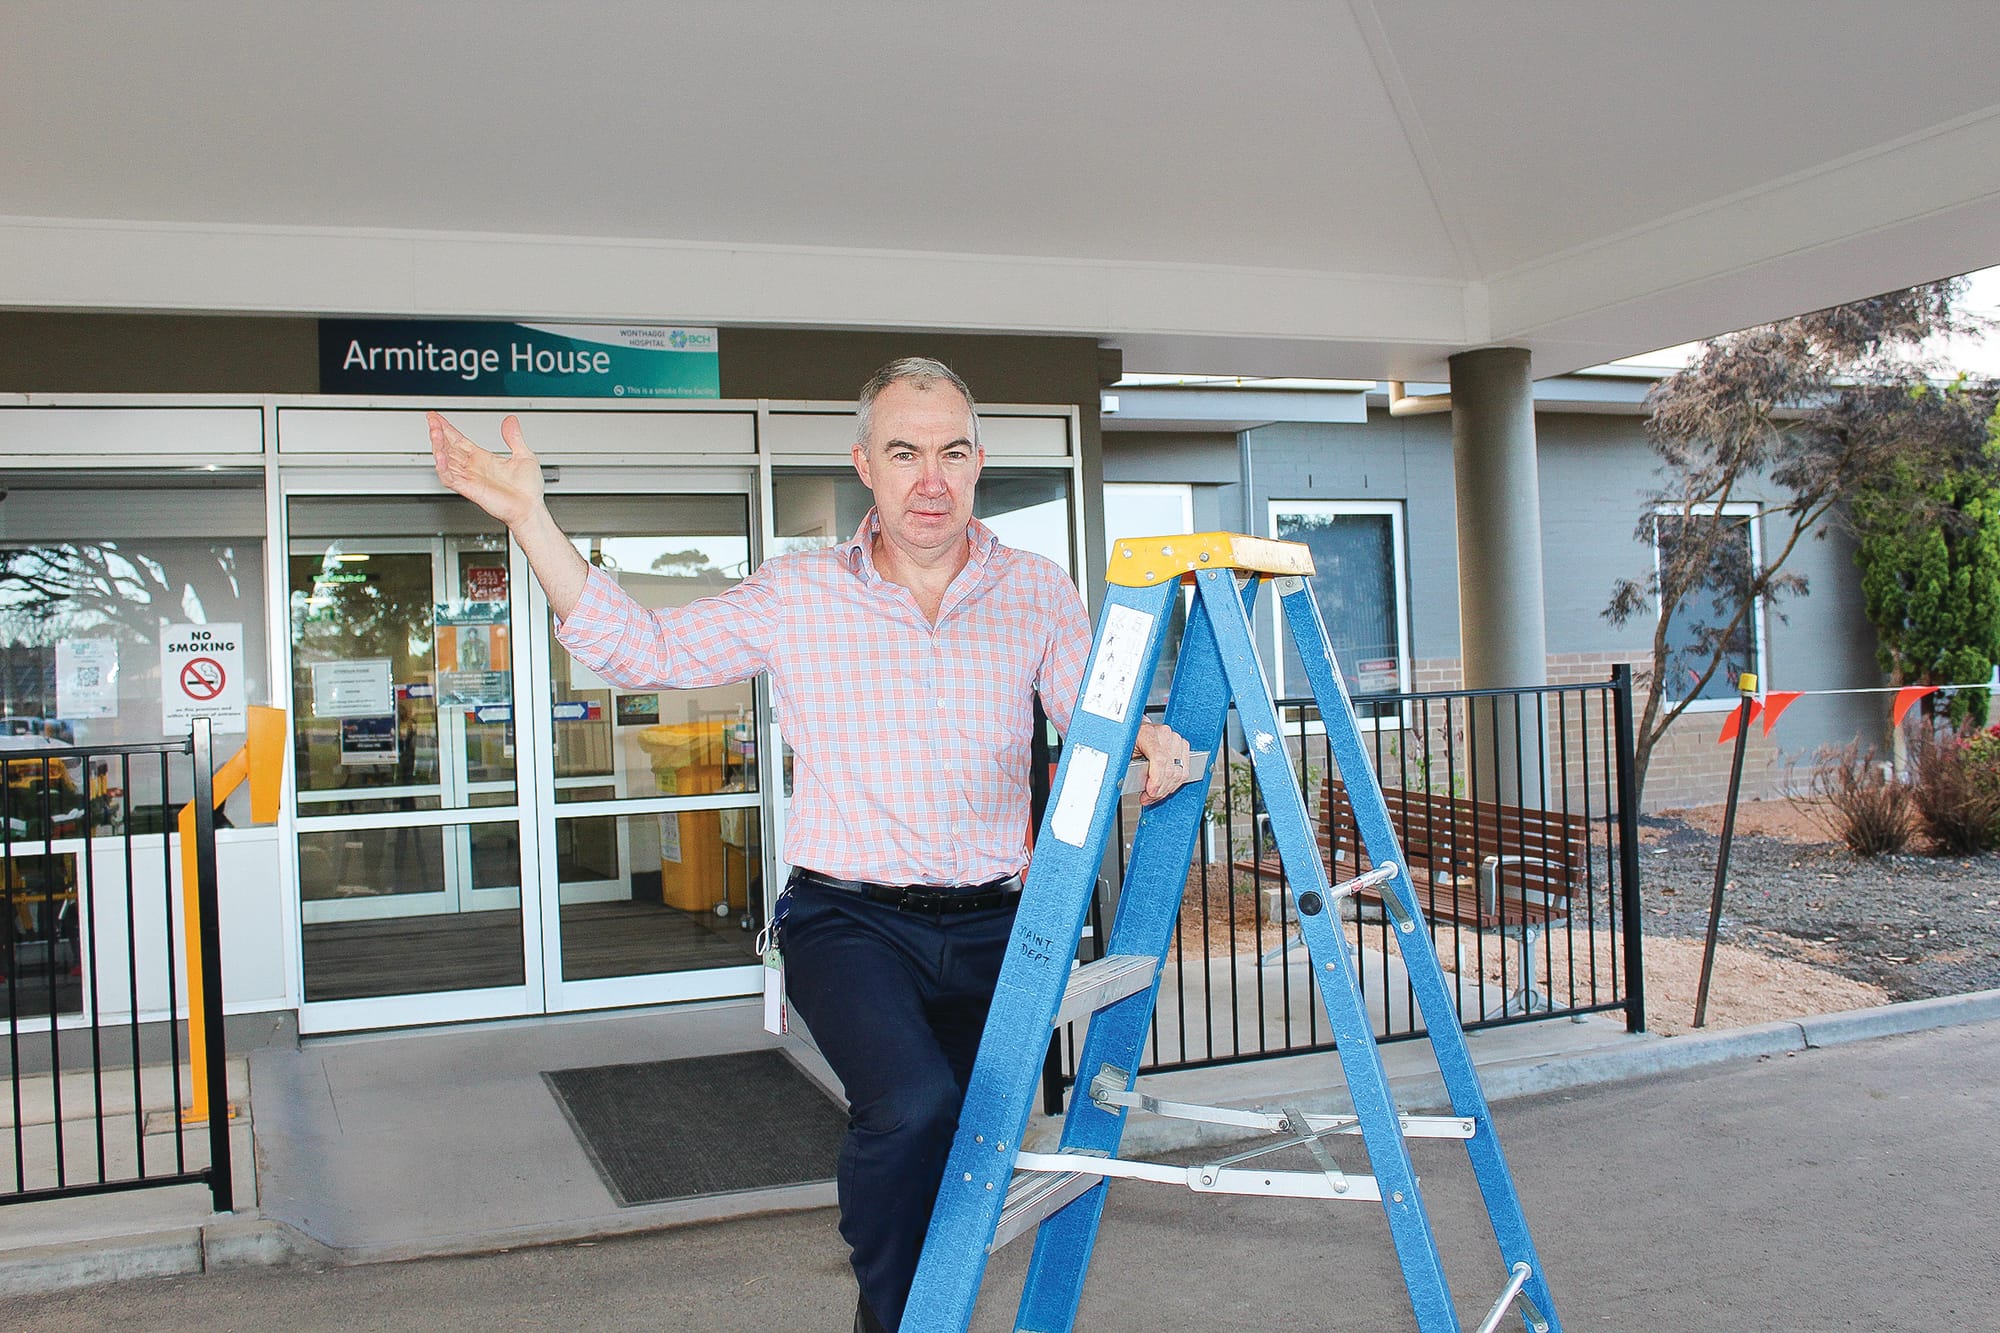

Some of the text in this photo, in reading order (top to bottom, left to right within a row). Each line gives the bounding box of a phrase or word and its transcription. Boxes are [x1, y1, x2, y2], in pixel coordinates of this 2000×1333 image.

[620, 329, 665, 337] WONTHAGGI
[629, 338, 665, 346] HOSPITAL
[688, 334, 711, 343] BCH
[343, 340, 611, 380] Armitage House
[626, 386, 640, 395] This
[191, 631, 212, 640] NO
[168, 642, 235, 653] SMOKING
